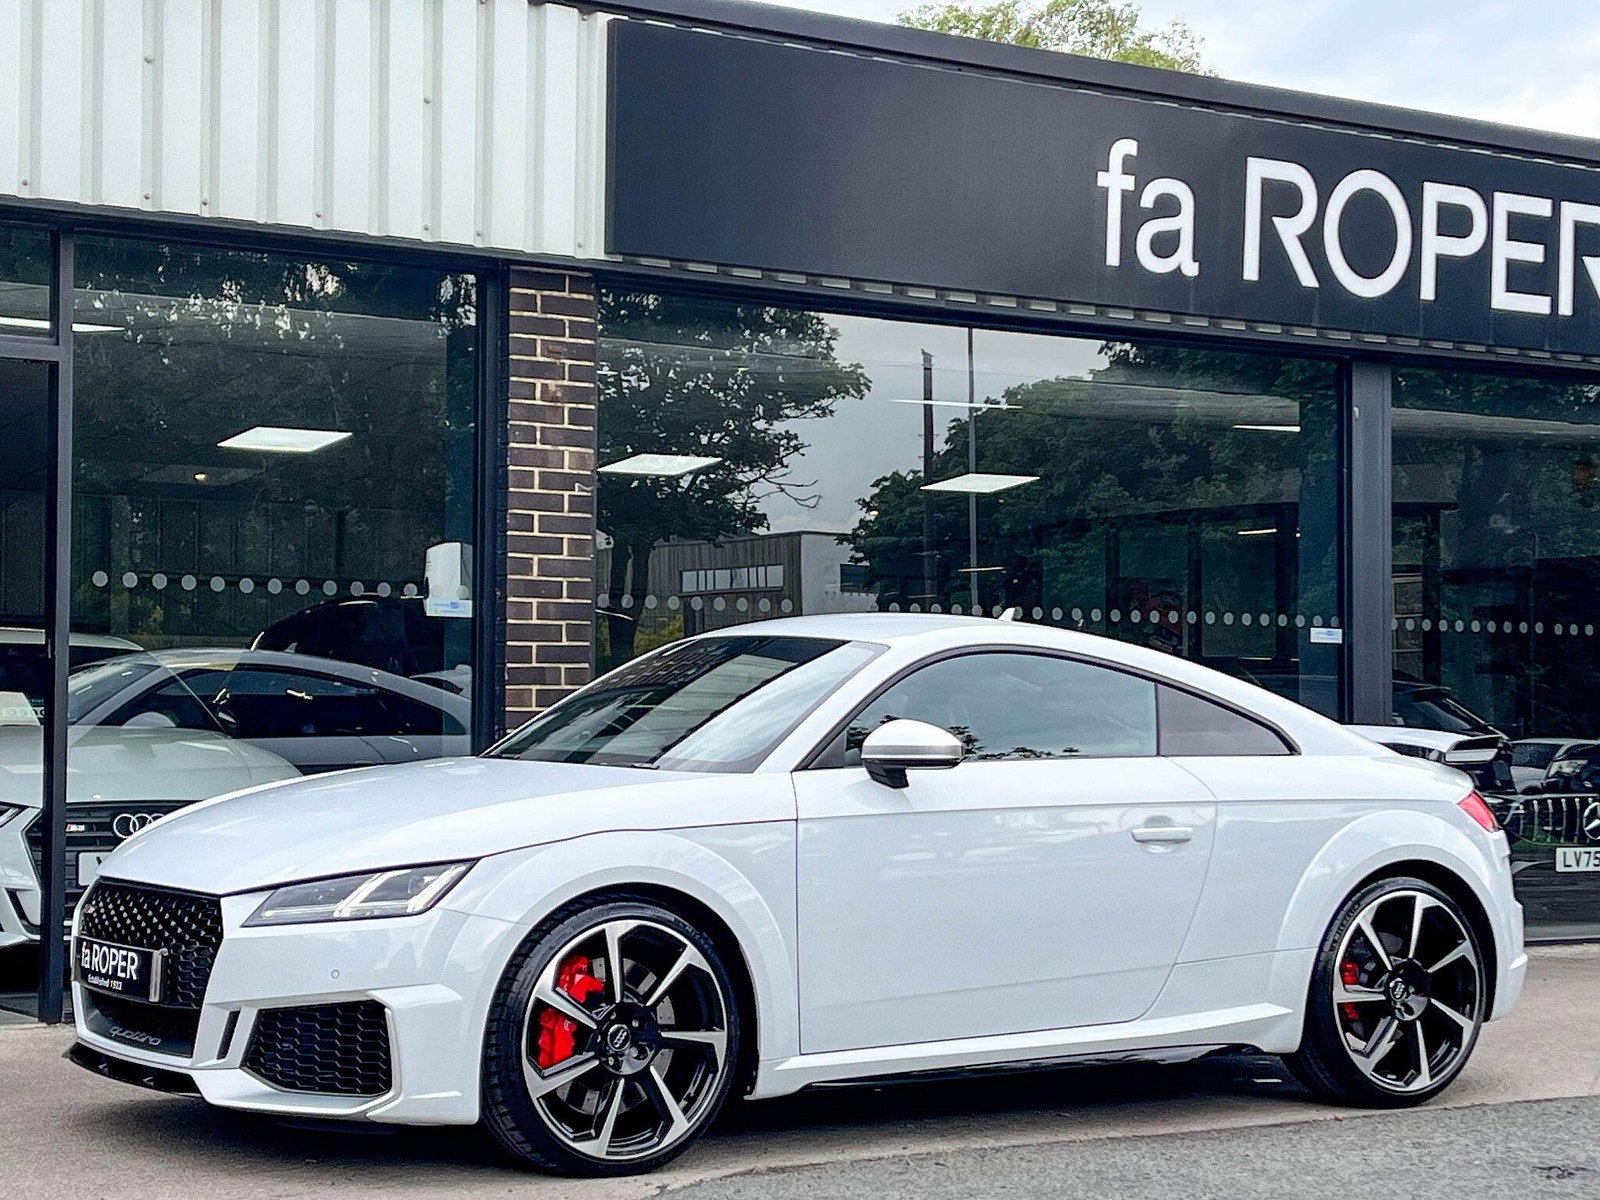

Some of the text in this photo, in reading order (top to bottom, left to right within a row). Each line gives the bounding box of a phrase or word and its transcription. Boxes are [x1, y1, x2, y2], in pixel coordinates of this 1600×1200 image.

[1096, 138, 1600, 316] fa ROPER
[1563, 850, 1600, 868] LV75
[81, 941, 138, 981] fa ROPER
[109, 1026, 162, 1046] quattro
